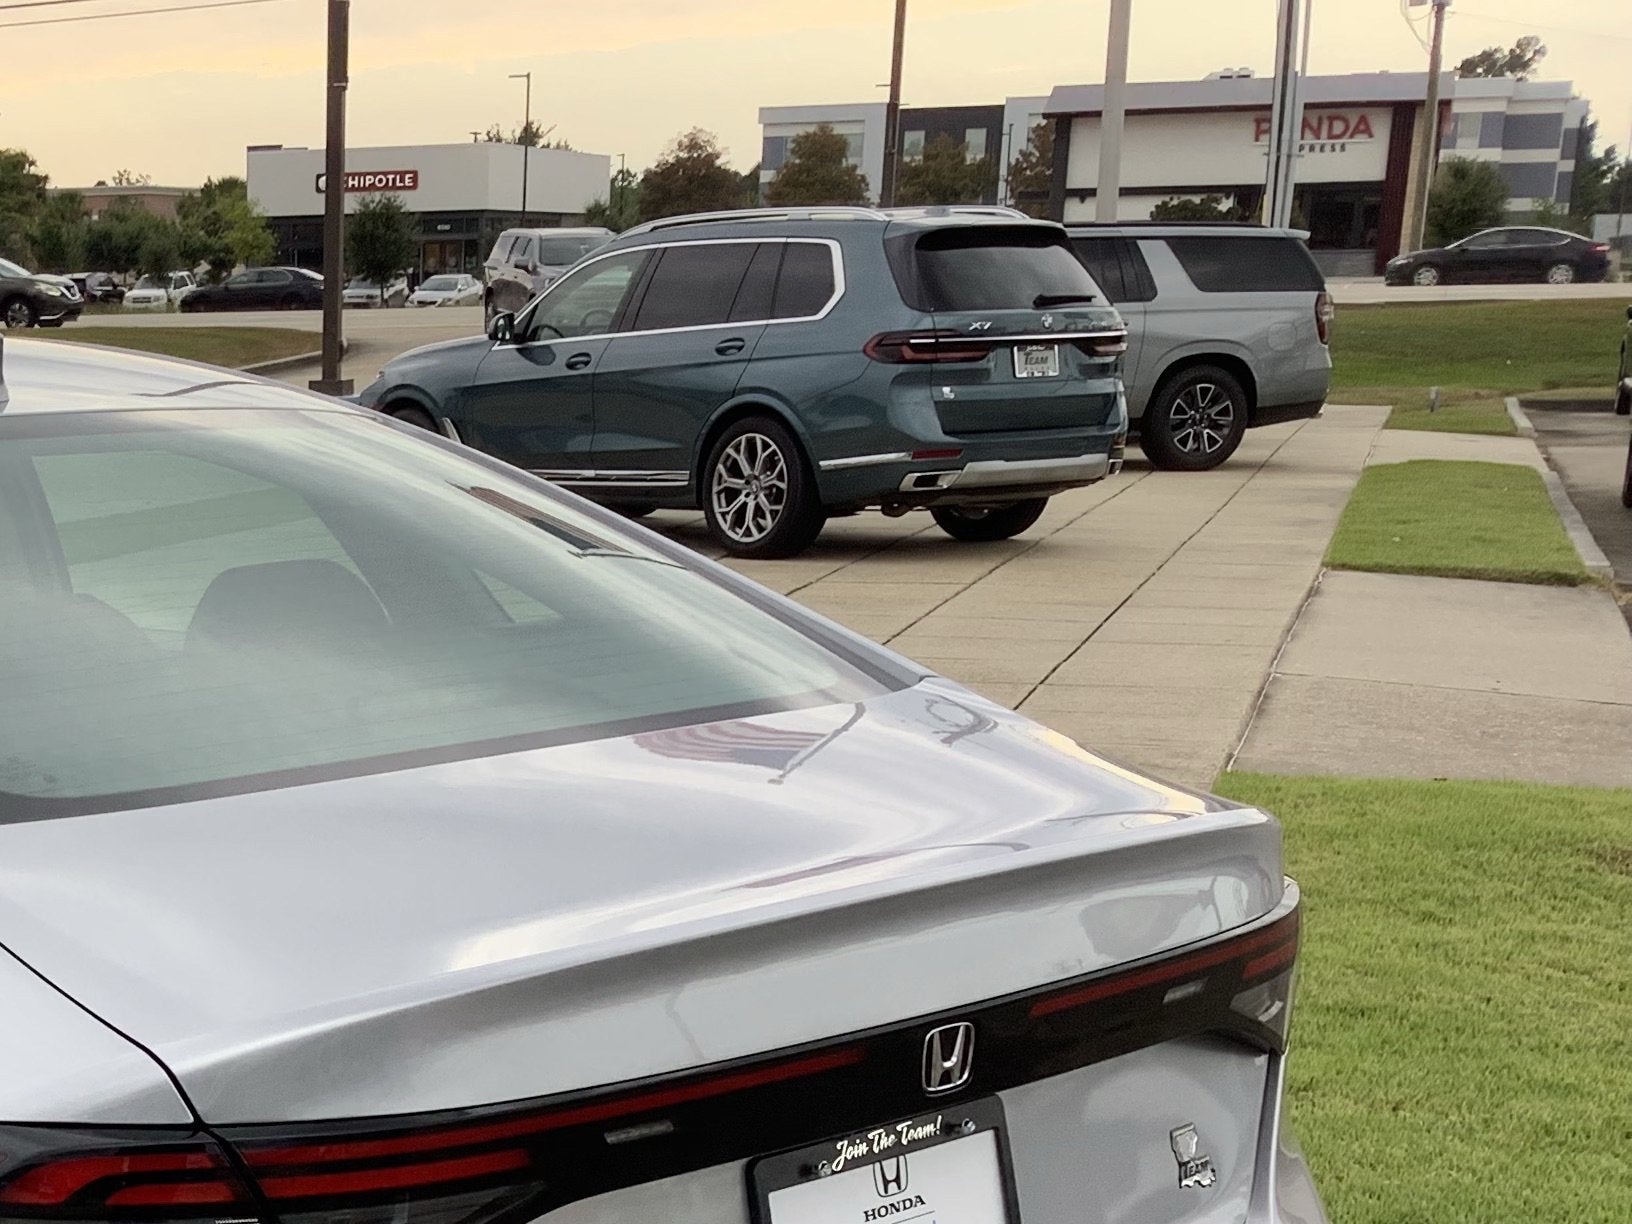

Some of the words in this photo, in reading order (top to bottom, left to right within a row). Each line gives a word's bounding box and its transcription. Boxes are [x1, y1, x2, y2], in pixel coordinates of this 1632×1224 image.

[1253, 114, 1374, 142] PNDA
[344, 173, 414, 188] HIPOTLE
[832, 1139, 870, 1172] Join
[867, 1128, 897, 1154] The
[895, 1115, 942, 1146] Team!
[863, 1194, 926, 1222] HONDA
